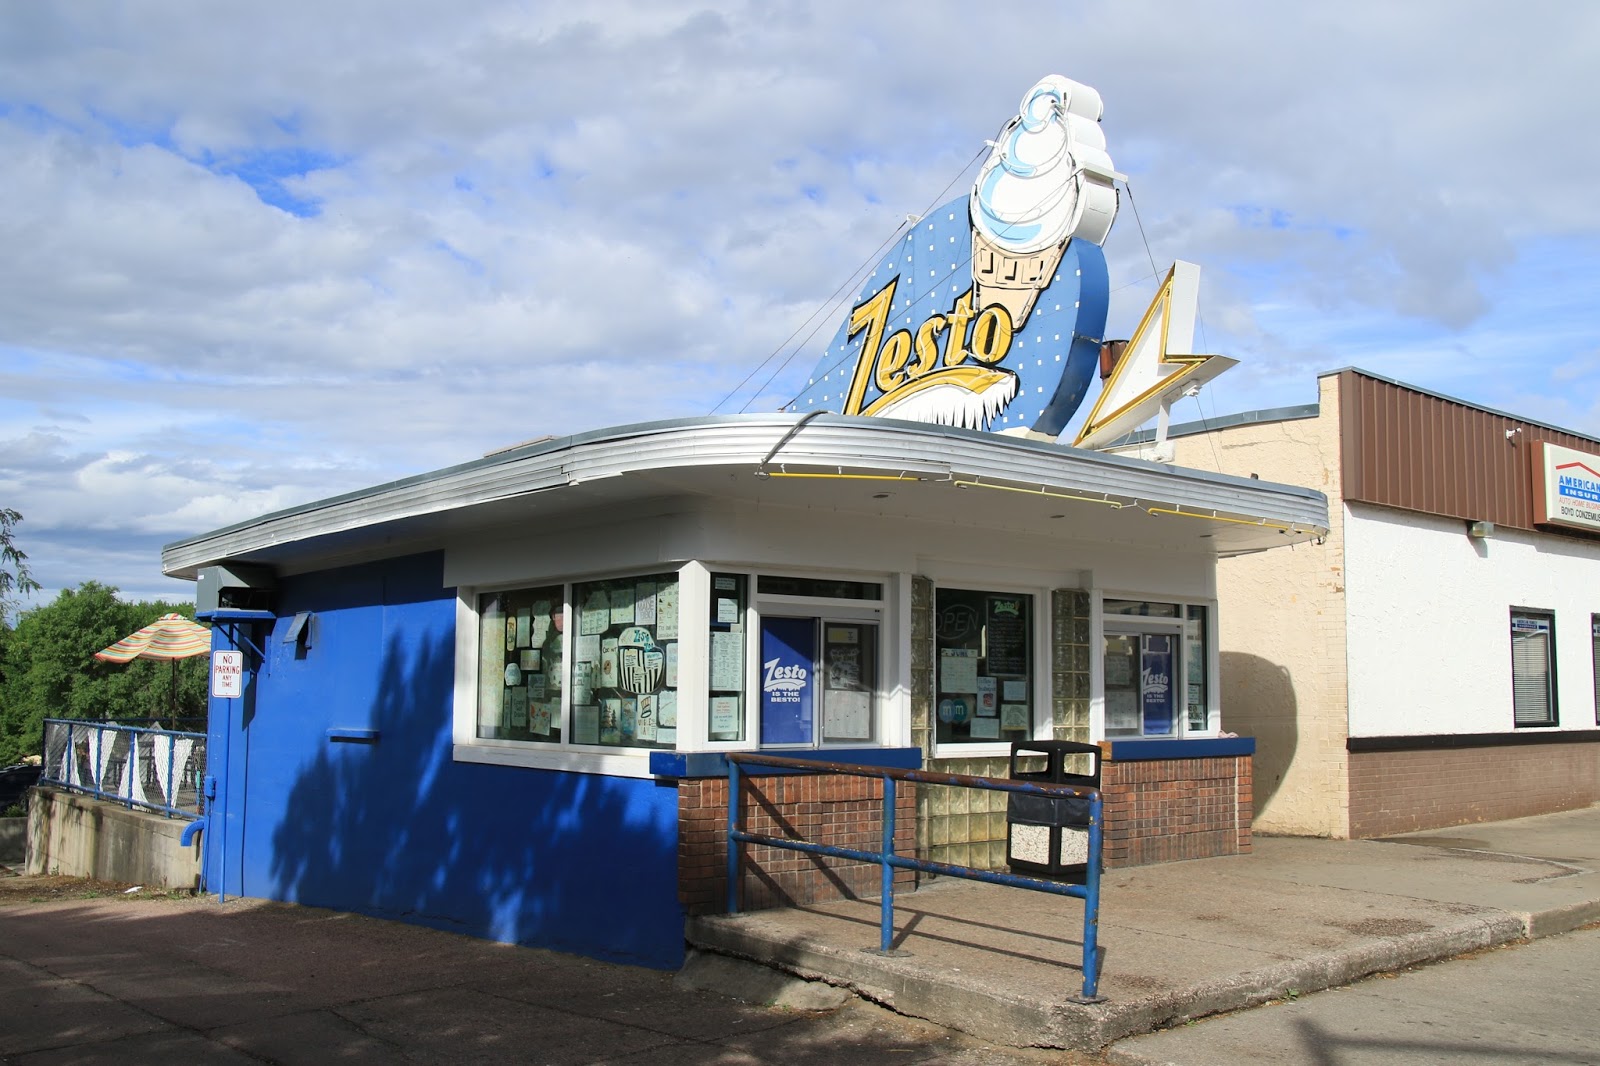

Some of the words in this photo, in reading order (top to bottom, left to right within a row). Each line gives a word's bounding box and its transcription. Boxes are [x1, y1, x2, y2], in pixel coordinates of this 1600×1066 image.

[842, 274, 1015, 415] Zesto
[1559, 475, 1600, 493] AMERICAN
[1565, 488, 1600, 501] INSUR
[1561, 506, 1574, 516] BOYD
[222, 655, 233, 664] NO
[216, 666, 240, 675] PARKING
[764, 657, 807, 691] Zesto
[1143, 667, 1169, 690] Zesto
